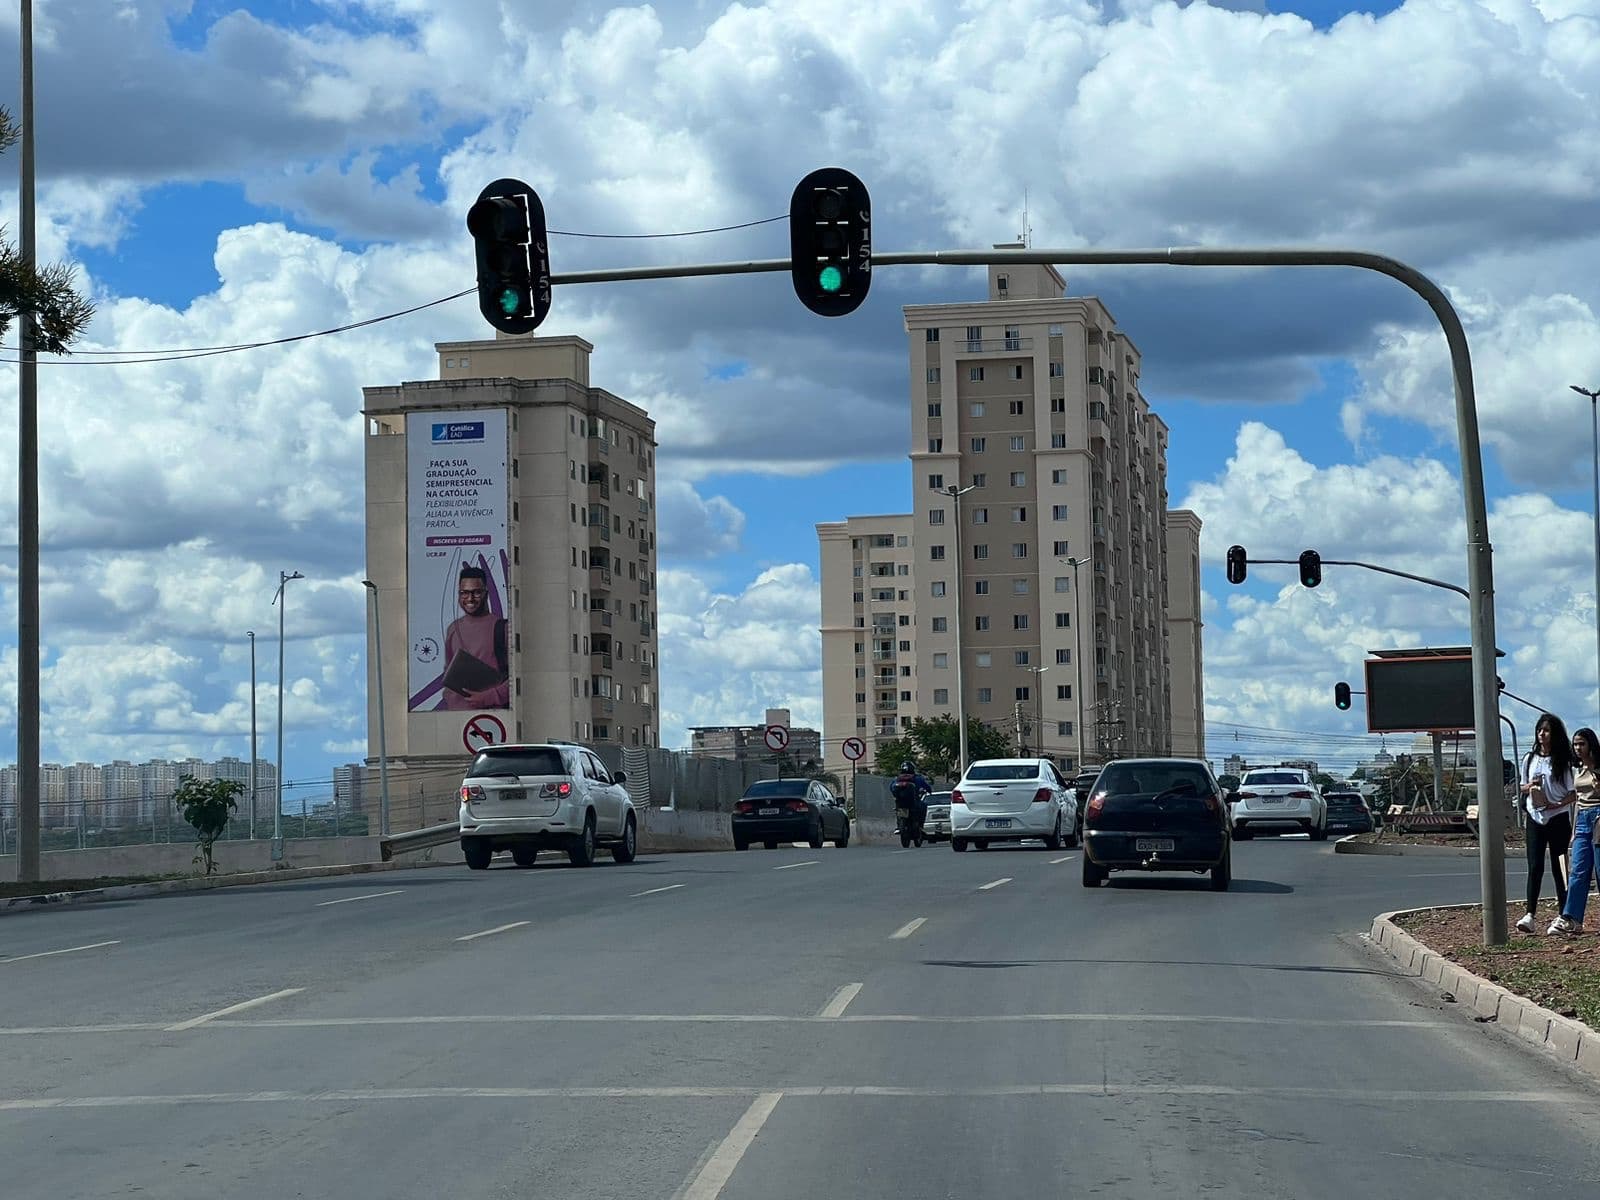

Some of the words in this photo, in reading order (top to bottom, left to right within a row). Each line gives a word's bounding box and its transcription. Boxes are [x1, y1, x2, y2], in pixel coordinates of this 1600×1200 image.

[452, 459, 468, 467] SUA
[426, 468, 477, 478] GRADUAÇÃO
[426, 478, 493, 488] SEMIPRESENCIAL
[426, 490, 438, 498] NA
[439, 489, 479, 498] CATÓLICA
[426, 499, 478, 508] FLEXIBILIDADE
[426, 510, 453, 518] ALIADA
[460, 508, 494, 517] VIVÊNCIA
